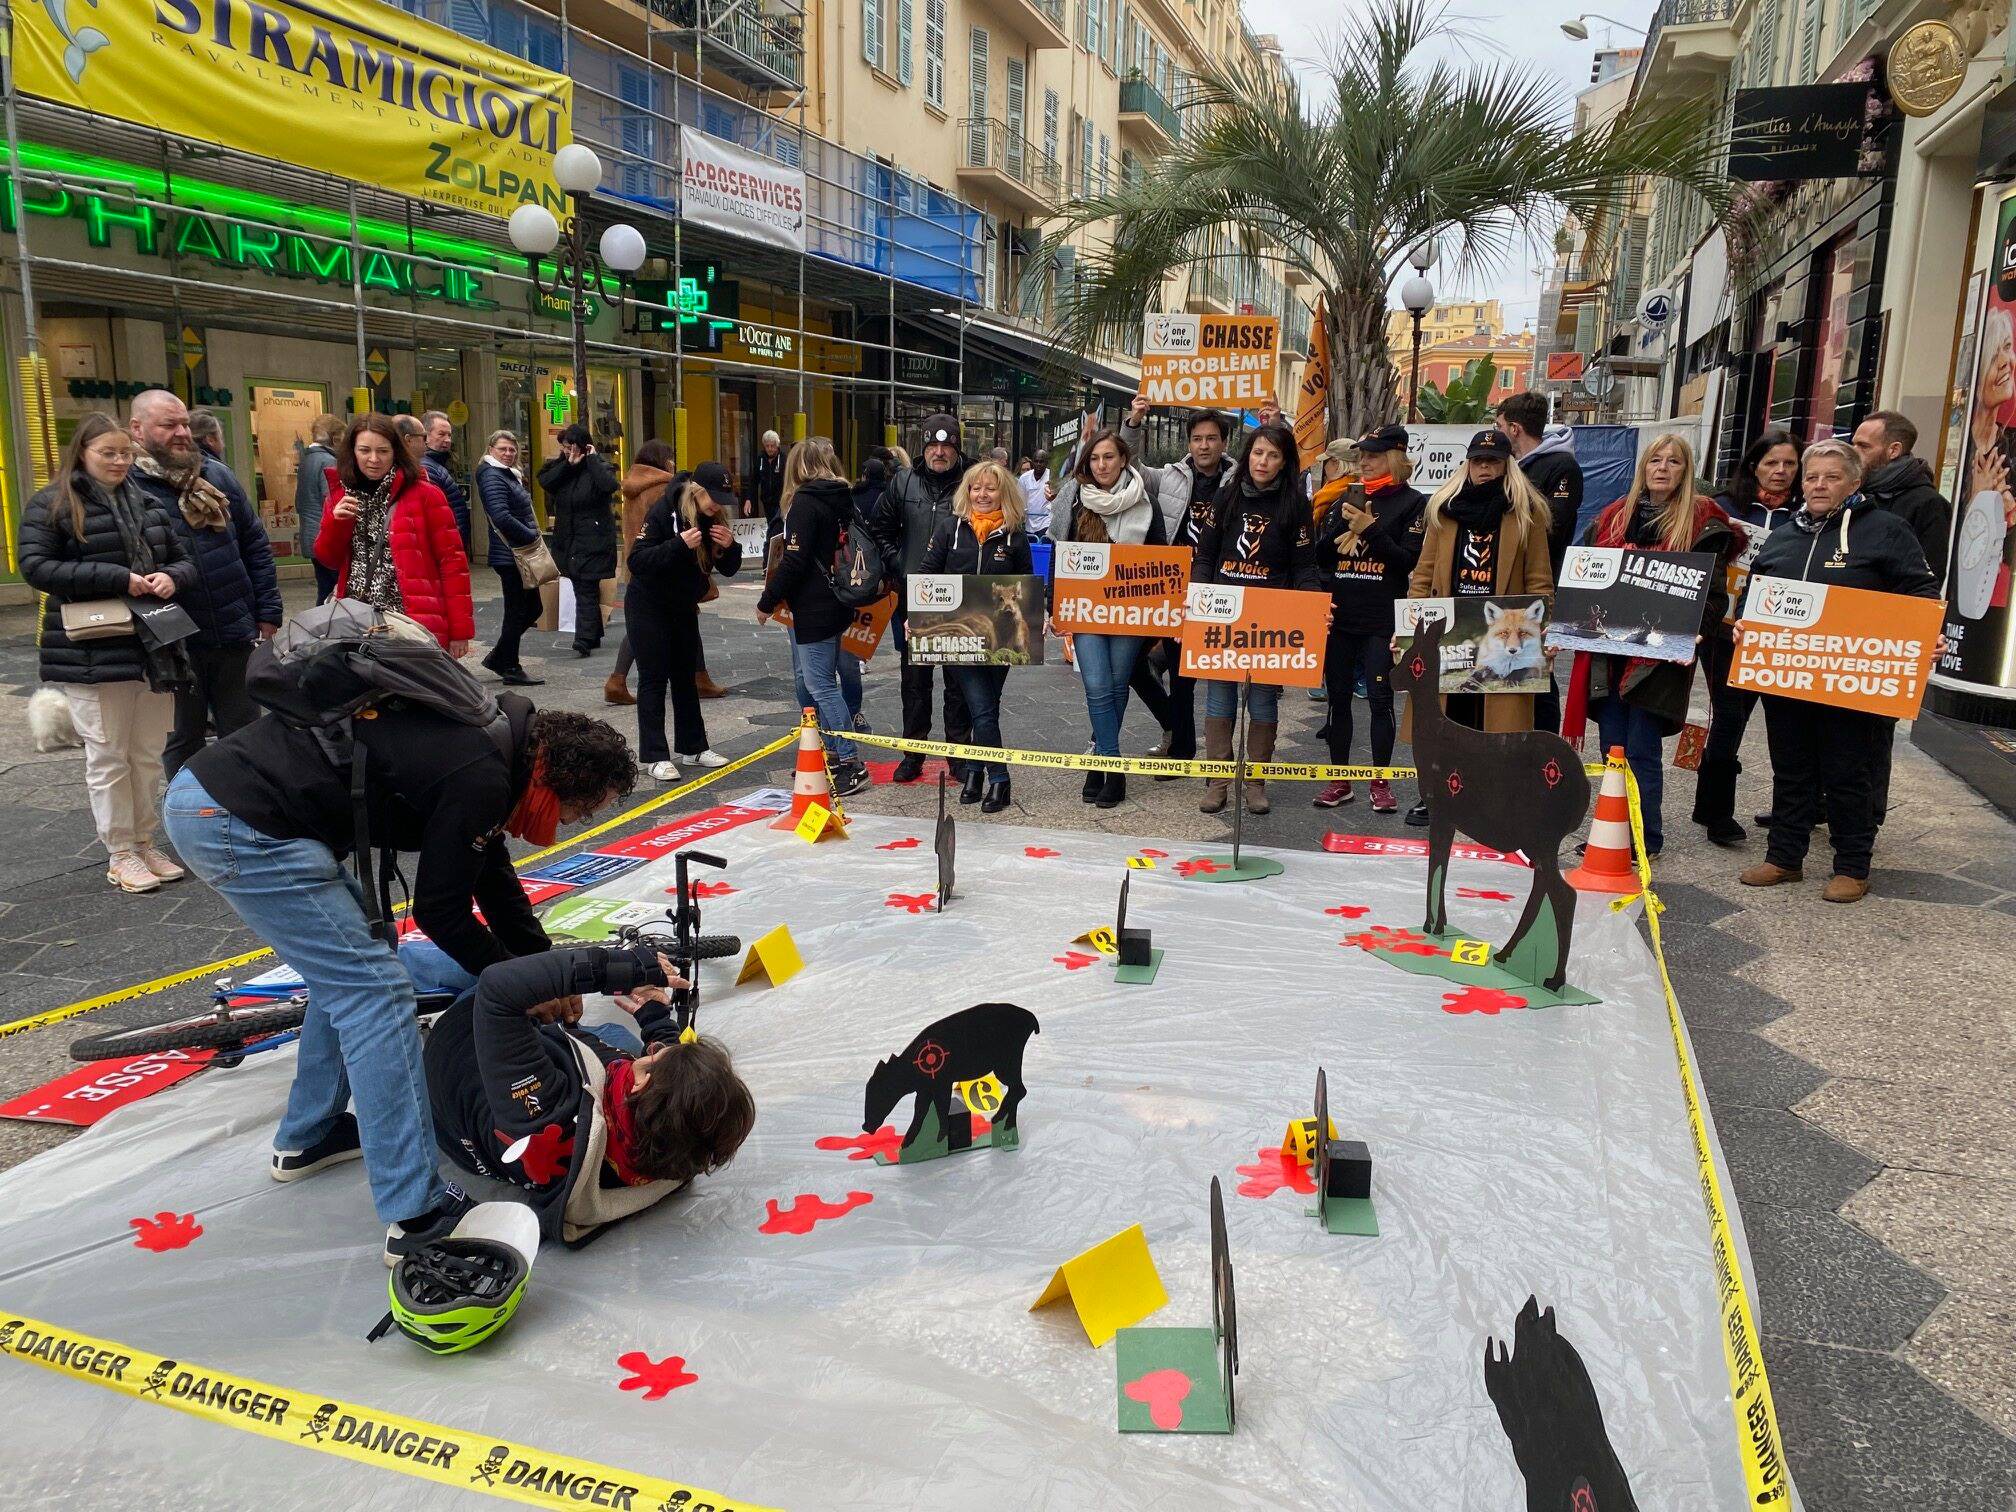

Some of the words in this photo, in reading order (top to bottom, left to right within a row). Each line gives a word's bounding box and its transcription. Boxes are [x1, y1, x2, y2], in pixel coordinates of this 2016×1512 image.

[151, 31, 384, 117] RAVALEMENT
[408, 116, 441, 134] DE
[425, 141, 567, 214] ZOLPAN
[684, 157, 803, 212] ACROSERVICES
[423, 187, 485, 210] L'EXPERTISE
[488, 203, 503, 215] QUI
[684, 185, 720, 209] TRAVAUX
[0, 173, 498, 304] PHARMACIE
[540, 293, 593, 316] Pharmie
[739, 325, 792, 351] L'OCCIANE
[1171, 328, 1186, 337] one
[1171, 337, 1191, 347] voice
[1202, 323, 1274, 350] CHASSE
[1143, 365, 1163, 377] UN
[1166, 352, 1271, 376] PROBLÈME
[1146, 374, 1268, 403] MORTEL
[1429, 450, 1453, 463] one
[1428, 464, 1458, 480] voic
[732, 523, 756, 537] ECTIF
[1082, 563, 1100, 571] voice
[1115, 561, 1185, 581] Nuisibles,
[1238, 560, 1271, 576] voice
[1353, 557, 1385, 574] voice
[1470, 567, 1492, 583] voi
[1589, 570, 1607, 579] voice
[1625, 554, 1645, 576] LA
[1645, 558, 1707, 590] CHASSE
[935, 595, 952, 603] voice
[1103, 581, 1166, 600] vraiment
[1169, 578, 1182, 594] ?!
[1786, 596, 1803, 605] one
[1058, 597, 1182, 628] #Renards
[1214, 605, 1232, 615] voice
[1784, 605, 1806, 617] voice
[1204, 623, 1305, 649] #Jaime
[1946, 622, 1965, 640] TIME
[911, 636, 929, 652] LA
[932, 636, 986, 653] CHASSE
[1742, 629, 1922, 658] PRÉSERVONS
[1186, 647, 1318, 670] LesRenards
[1741, 651, 1766, 665] LA
[1771, 653, 1918, 677] BIODIVERSITÉ
[1738, 667, 1814, 691] POUR
[1822, 673, 1900, 698] TOUS
[1905, 680, 1917, 699] !
[907, 741, 948, 752] DANGER
[963, 748, 1004, 760] DANGER
[1021, 753, 1063, 765] DANGER
[1079, 758, 1122, 768] DANGER
[1139, 761, 1182, 772] DANGER
[1199, 763, 1241, 775] ANGER
[1261, 766, 1308, 777] DANGER
[1326, 767, 1373, 779] DANGER
[1392, 770, 1417, 780] GER
[1363, 841, 1507, 862] CHSSE
[1460, 941, 1484, 964] 2
[61, 1049, 191, 1102] ASSE
[1727, 1304, 1757, 1383] DANGER
[1745, 1391, 1781, 1487] DANGER
[15, 1330, 131, 1382] DANGER
[169, 1371, 291, 1426] DANGER
[331, 1413, 461, 1470] DANGER
[501, 1459, 640, 1512] DANGER
